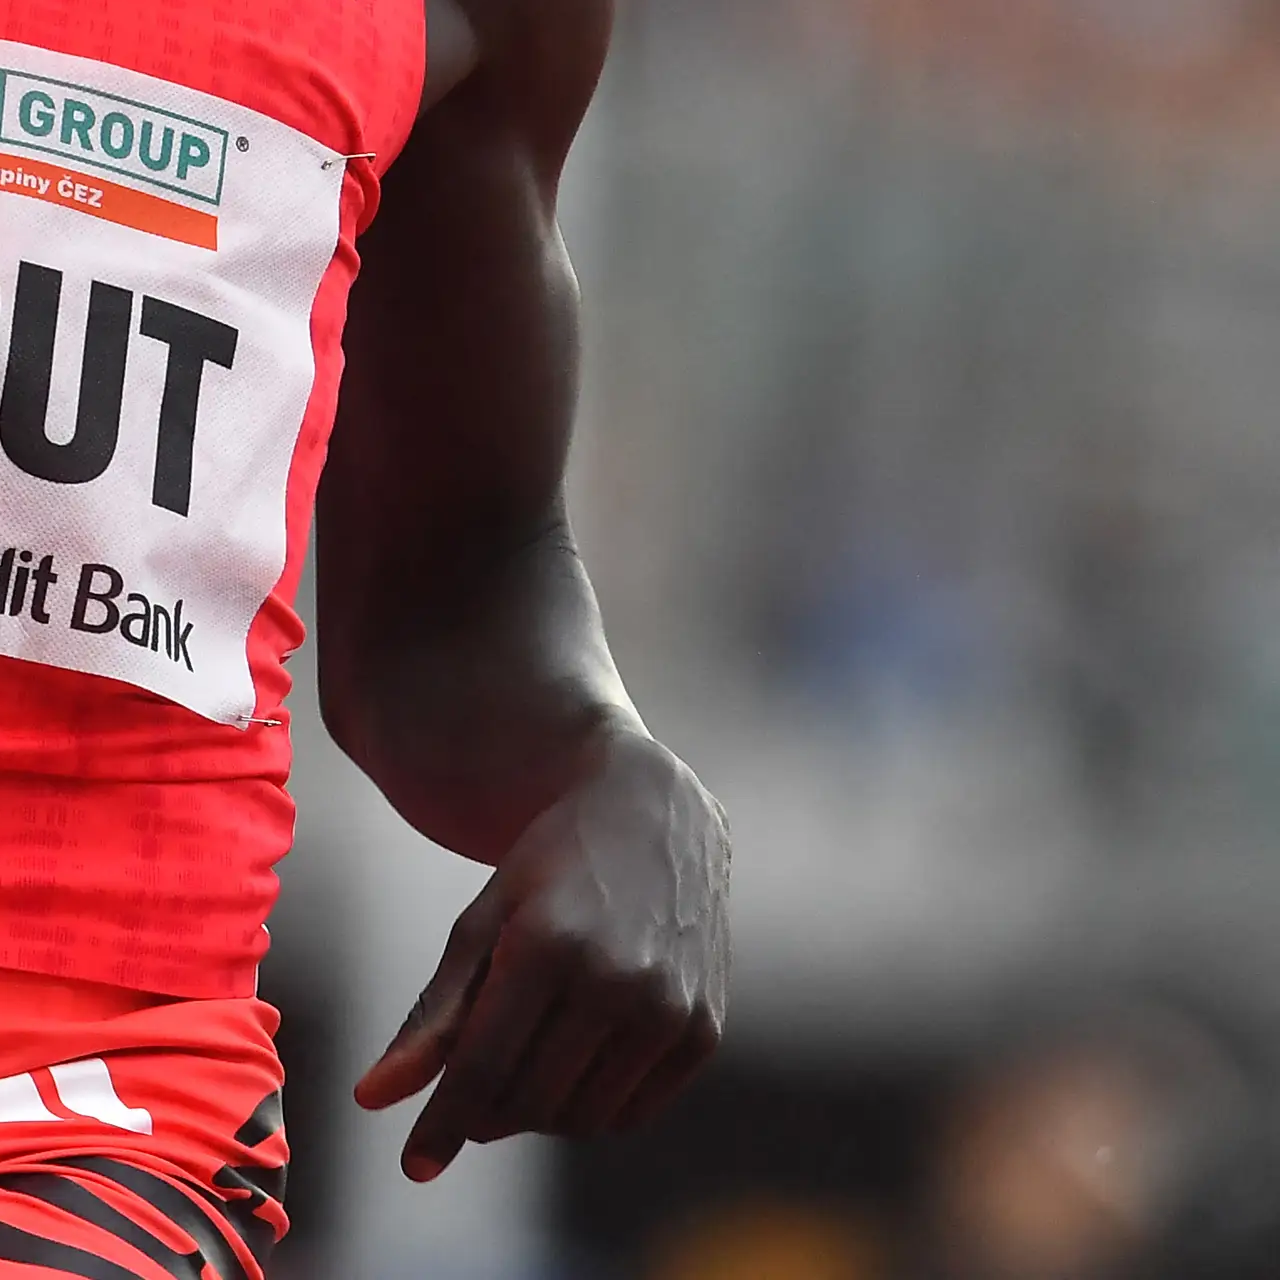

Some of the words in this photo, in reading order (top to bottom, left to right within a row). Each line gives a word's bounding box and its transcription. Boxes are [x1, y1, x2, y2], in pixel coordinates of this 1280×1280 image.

[18, 90, 211, 181] GROUP
[57, 174, 104, 208] ČEZ
[70, 564, 195, 672] Bank
